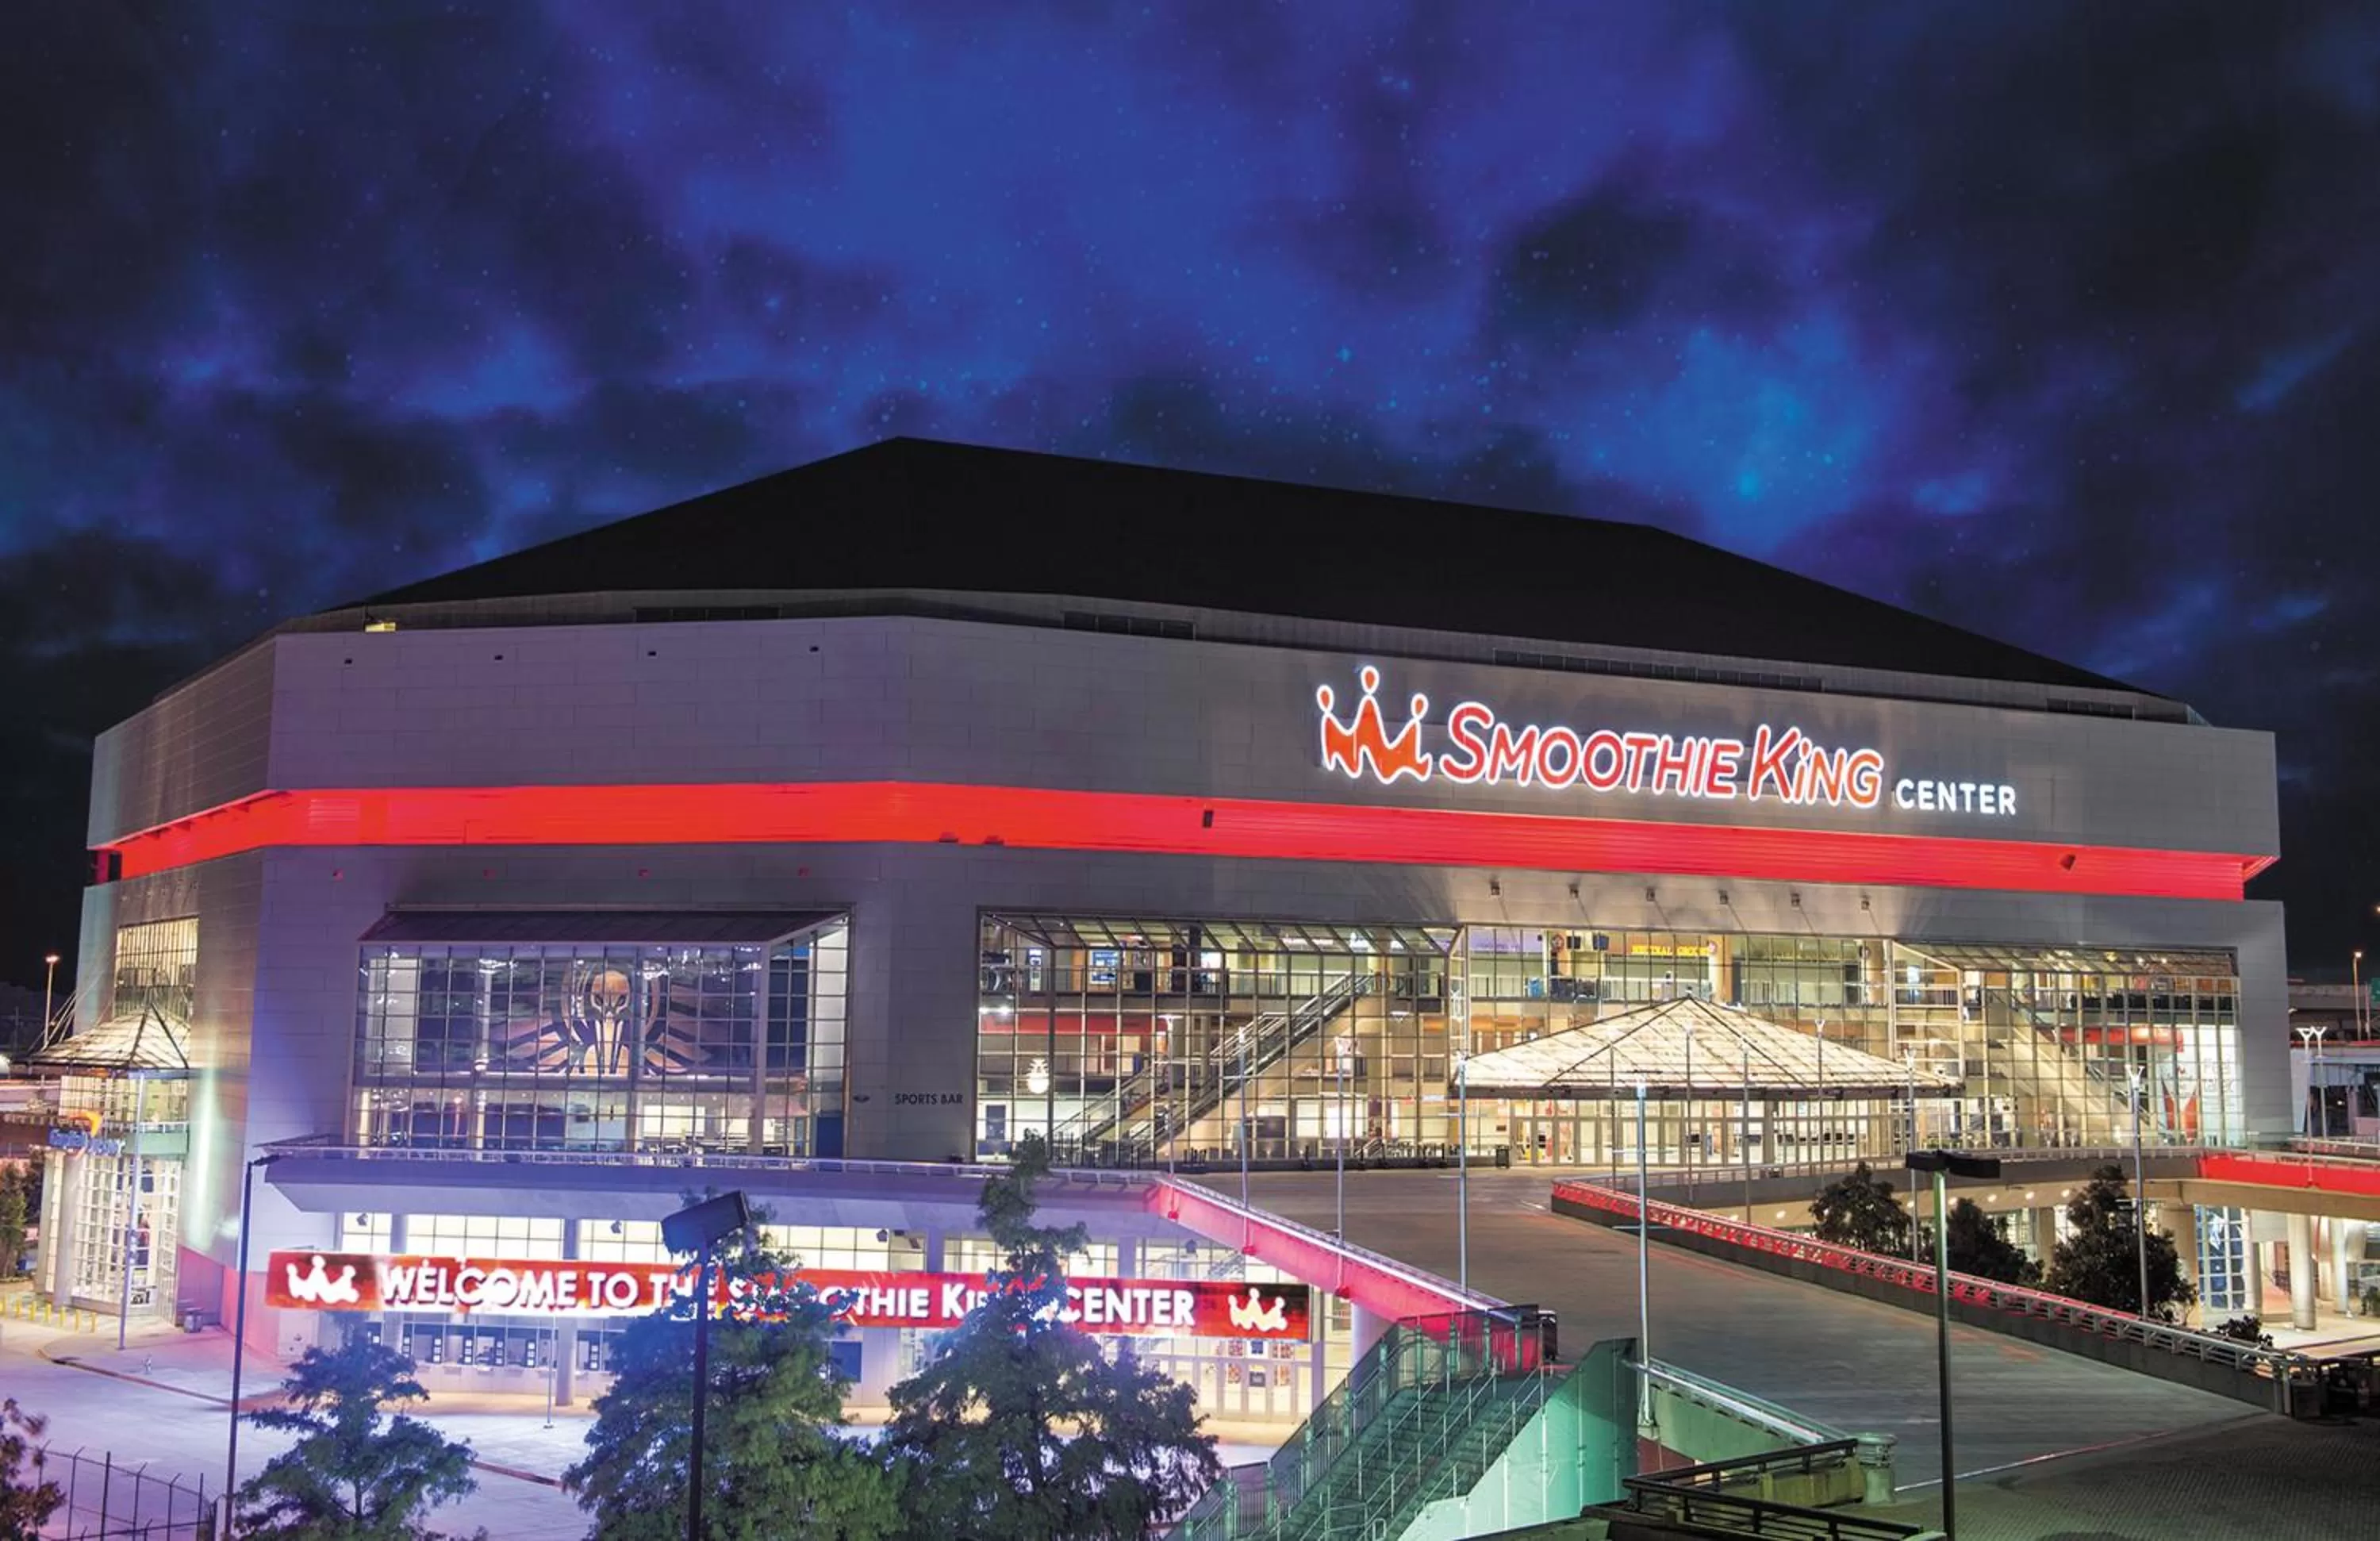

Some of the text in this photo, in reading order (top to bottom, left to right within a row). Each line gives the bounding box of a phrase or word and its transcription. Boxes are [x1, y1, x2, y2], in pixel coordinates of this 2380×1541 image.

[1440, 701, 1745, 799] SMOOTHIE
[1895, 778, 2017, 815] CENTER
[894, 1093, 963, 1105] SPORTS BAR
[381, 1266, 578, 1308] WELCOME
[587, 1271, 639, 1309] TO
[1060, 1286, 1194, 1325] CENTER
